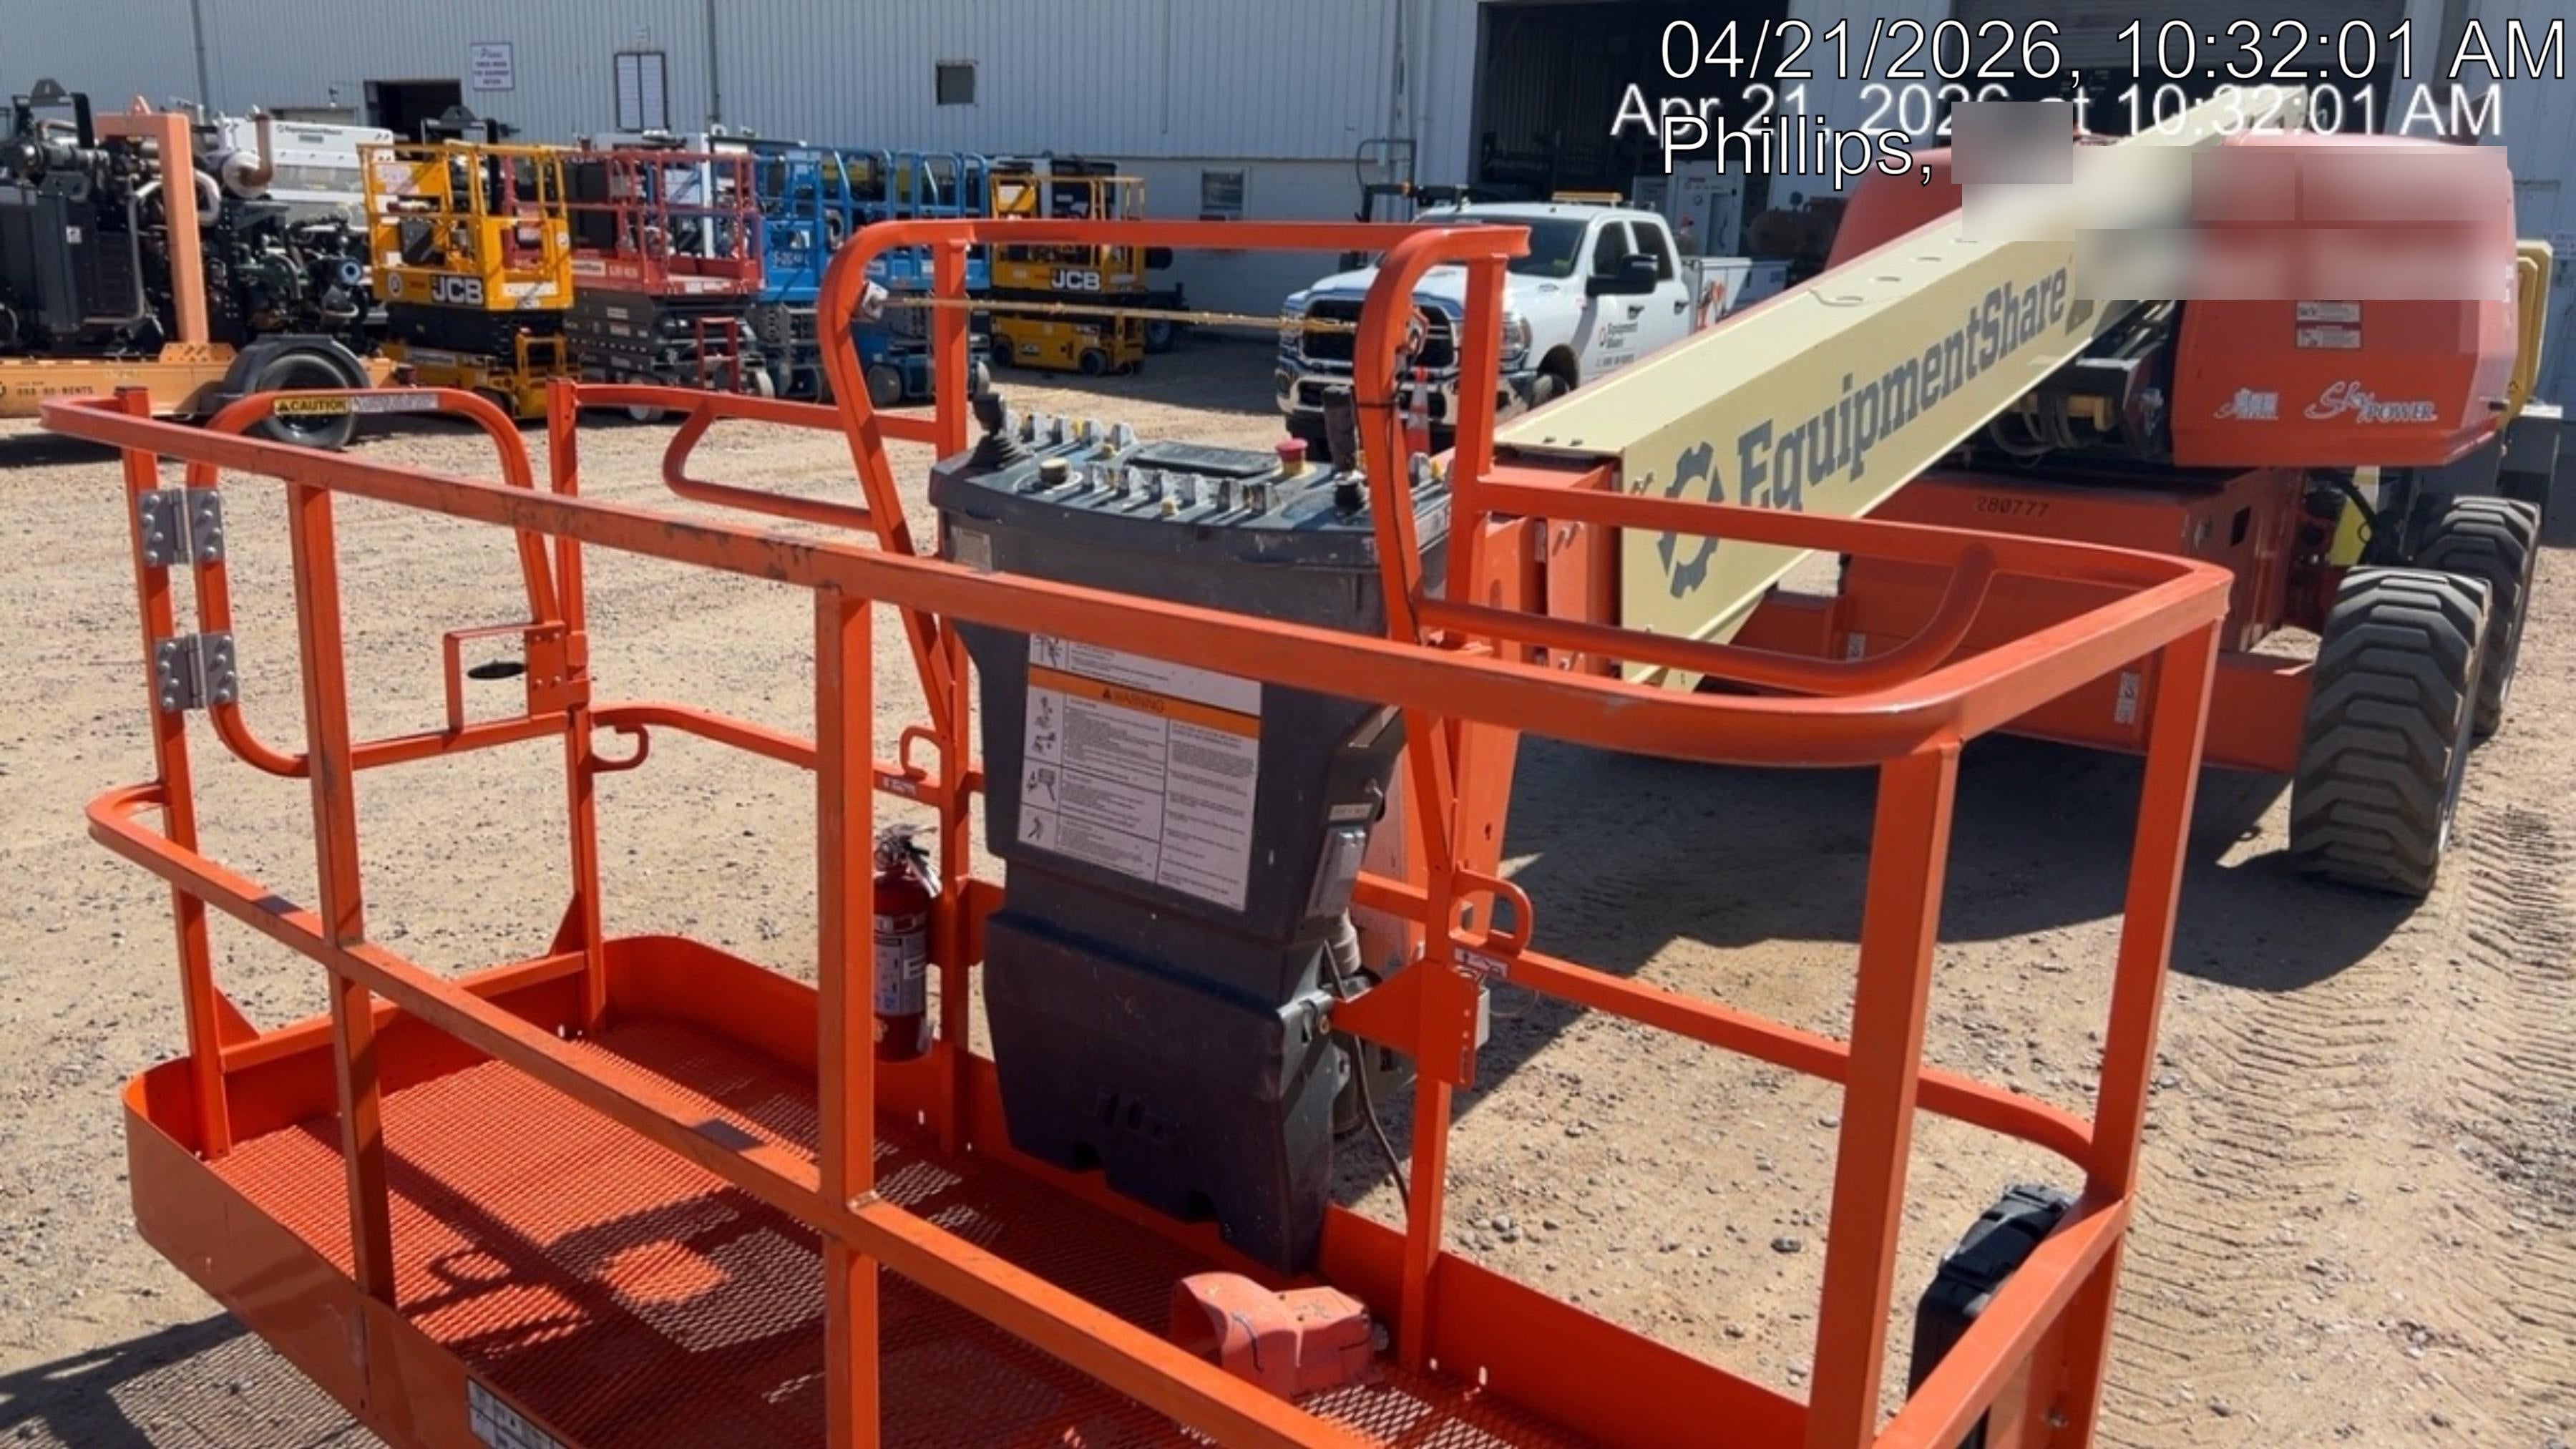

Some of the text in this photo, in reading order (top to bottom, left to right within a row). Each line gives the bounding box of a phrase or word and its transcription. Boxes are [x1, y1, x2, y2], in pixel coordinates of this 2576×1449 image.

[432, 275, 484, 305] JCB
[1051, 269, 1101, 291] JCB
[1737, 267, 2067, 512] EquipmentShare
[290, 399, 346, 412] CAUTION
[1976, 494, 2051, 517] 280777
